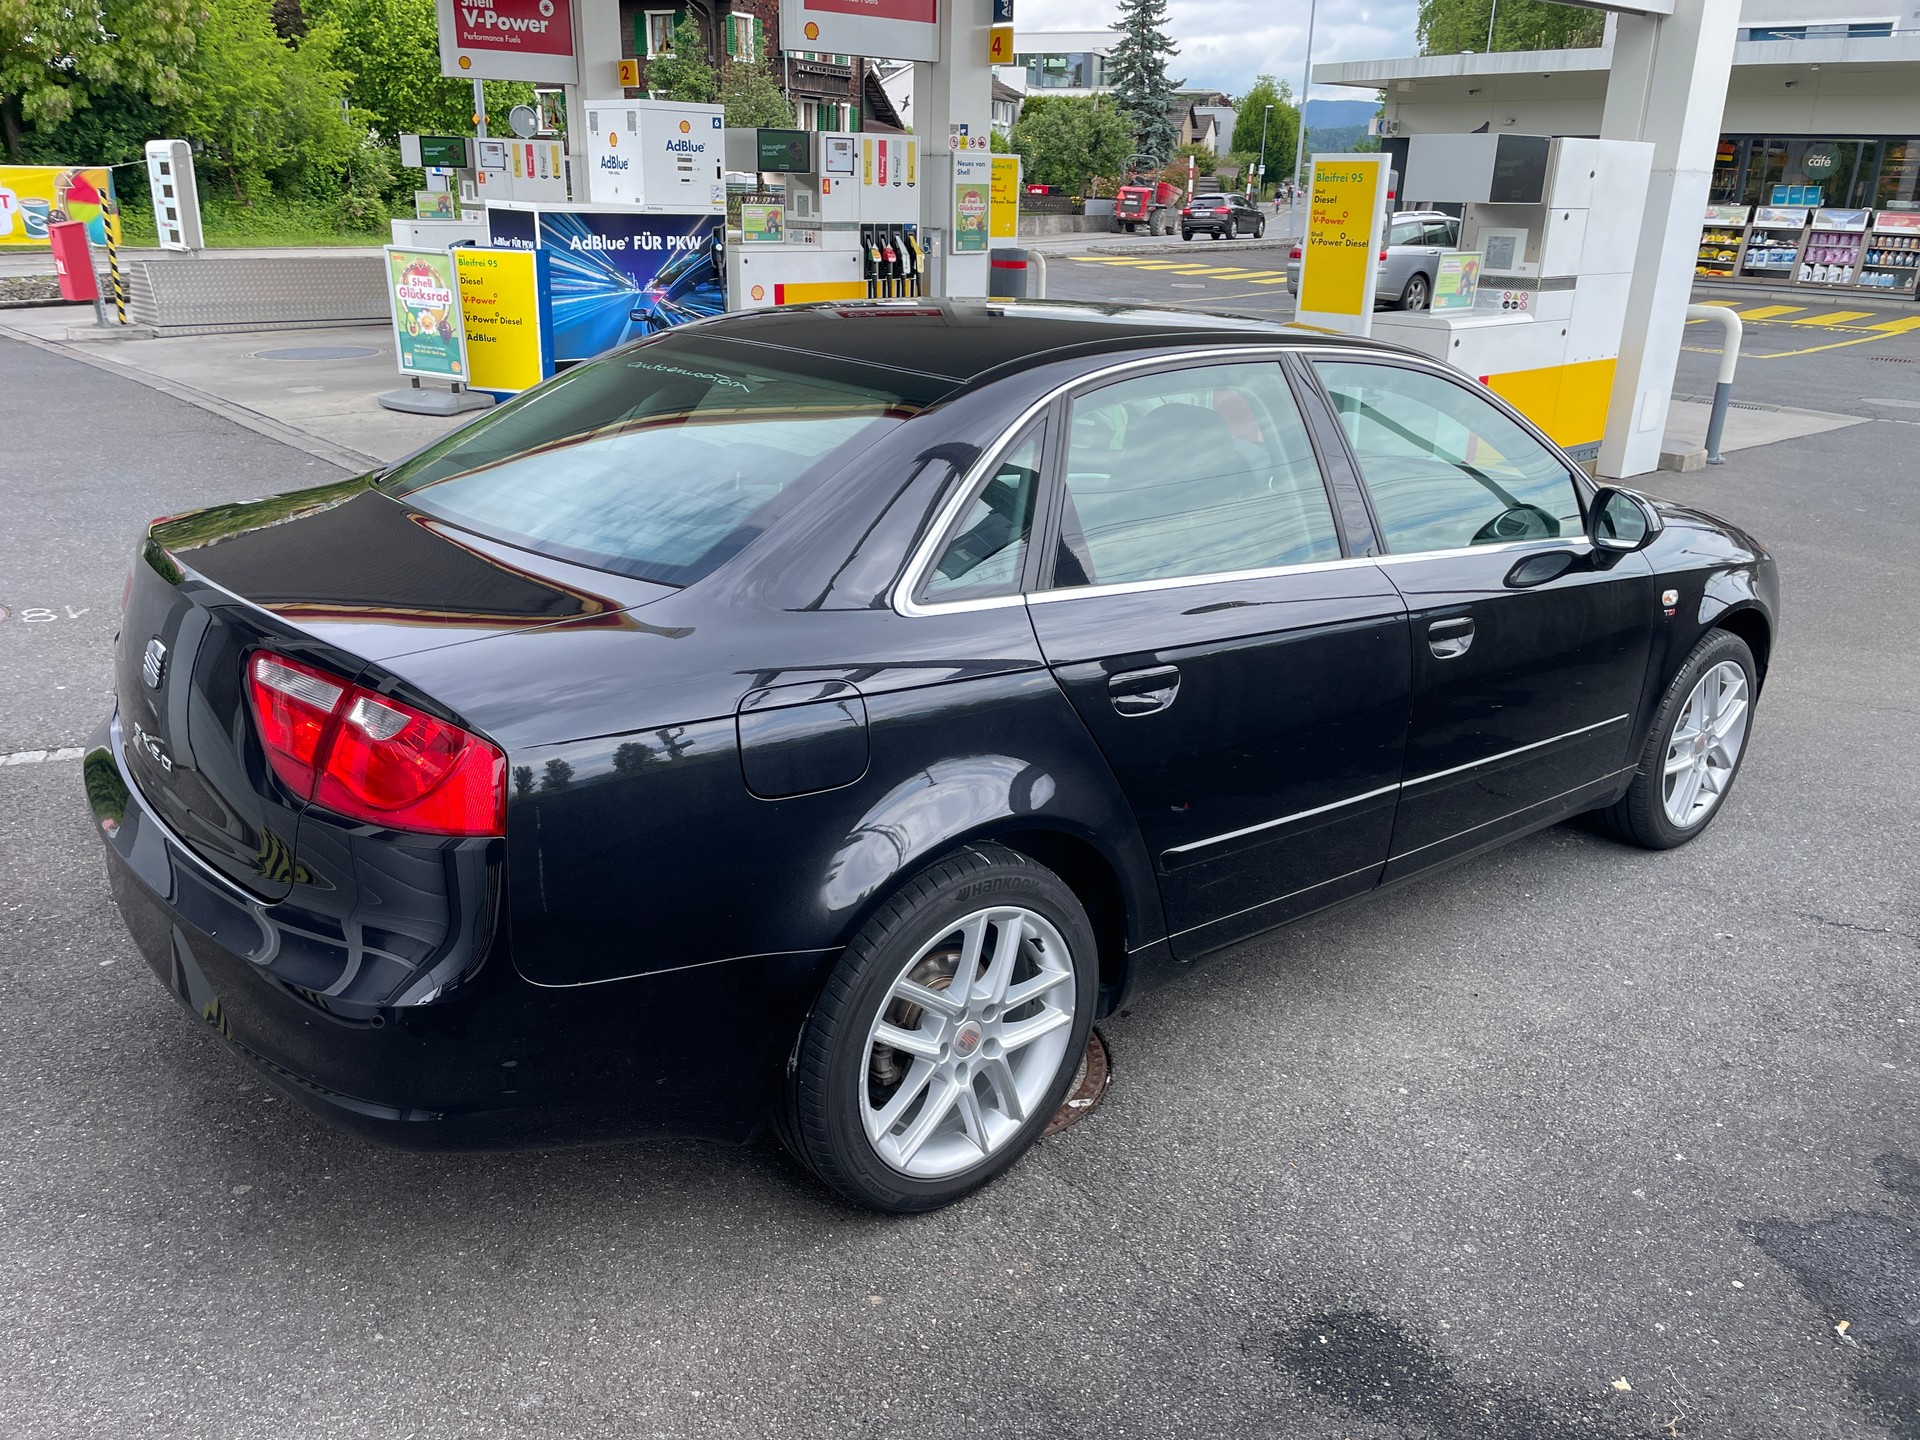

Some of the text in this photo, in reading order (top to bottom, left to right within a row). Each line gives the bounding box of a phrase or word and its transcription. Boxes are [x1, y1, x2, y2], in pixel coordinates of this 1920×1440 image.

[462, 8, 549, 33] V-Power
[463, 32, 521, 44] Performance Fuels
[991, 36, 1002, 56] 4
[621, 65, 630, 81] 2
[665, 139, 705, 153] AdBlue
[600, 155, 629, 170] AdBlue
[1808, 155, 1831, 167] café
[479, 172, 486, 183] 2
[1316, 173, 1363, 183] Bleifrei 95
[823, 179, 830, 193] 4
[1314, 195, 1337, 204] Diesel
[1313, 216, 1345, 225] V-Power
[570, 231, 702, 250] AdBlue FÜR PKW
[1310, 238, 1369, 248] V-Power Diesel
[458, 258, 498, 268] Bleifrei 95
[412, 277, 433, 288] Shell
[460, 276, 483, 285] Diesel
[399, 286, 450, 302] Glücksrad
[462, 295, 497, 305] V-Power
[464, 314, 523, 325] V-Power Diesel
[467, 333, 497, 343] AdBlue
